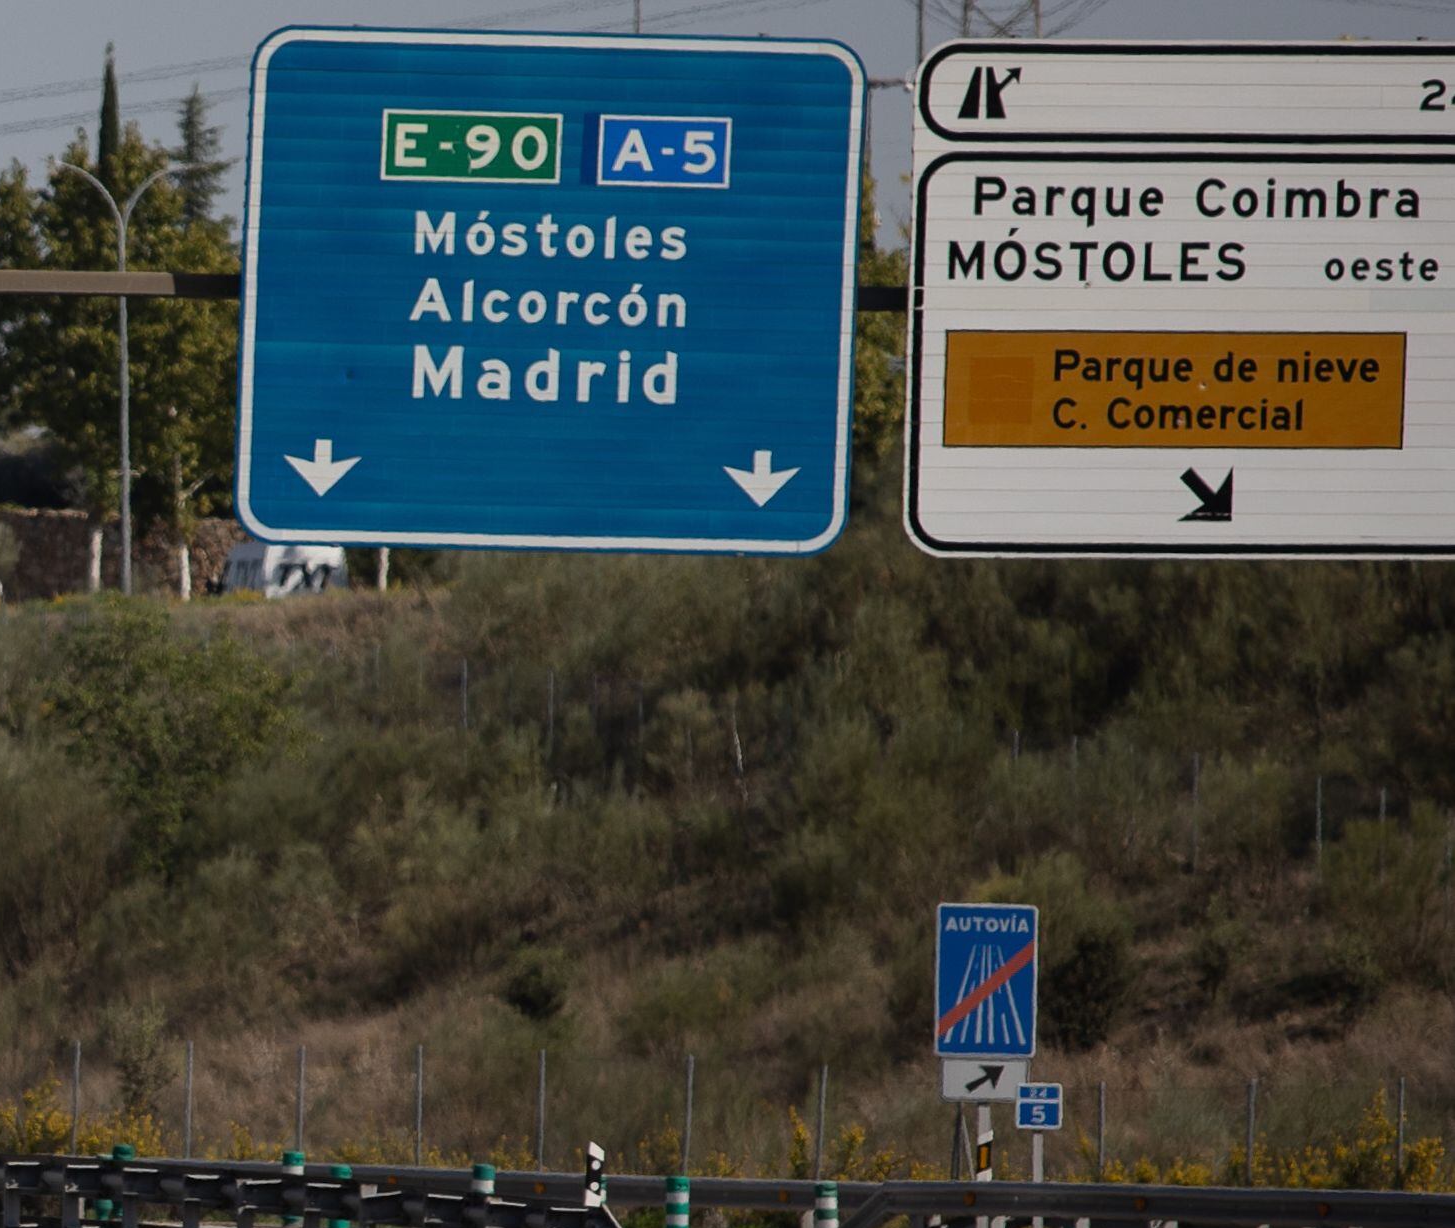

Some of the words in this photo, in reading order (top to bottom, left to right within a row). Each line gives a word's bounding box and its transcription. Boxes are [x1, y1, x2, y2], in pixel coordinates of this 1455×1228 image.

[1419, 79, 1455, 111] 2
[394, 122, 548, 171] E-90
[611, 128, 716, 174] A-5
[974, 176, 1164, 227] Parque
[1196, 177, 1420, 218] Coimbra
[414, 210, 687, 260] Móstoles
[947, 227, 1246, 281] MÓSTOLES
[1324, 251, 1439, 281] oeste
[409, 278, 686, 327] Alcorcón
[411, 345, 678, 405] Madrid
[1053, 349, 1193, 390] Parque
[1213, 352, 1257, 382] de
[1278, 351, 1379, 382] nieve
[1053, 397, 1087, 430] C.
[1107, 397, 1303, 431] Comercial
[945, 913, 1029, 933] AUTOVÍA
[1031, 1105, 1045, 1123] 5
